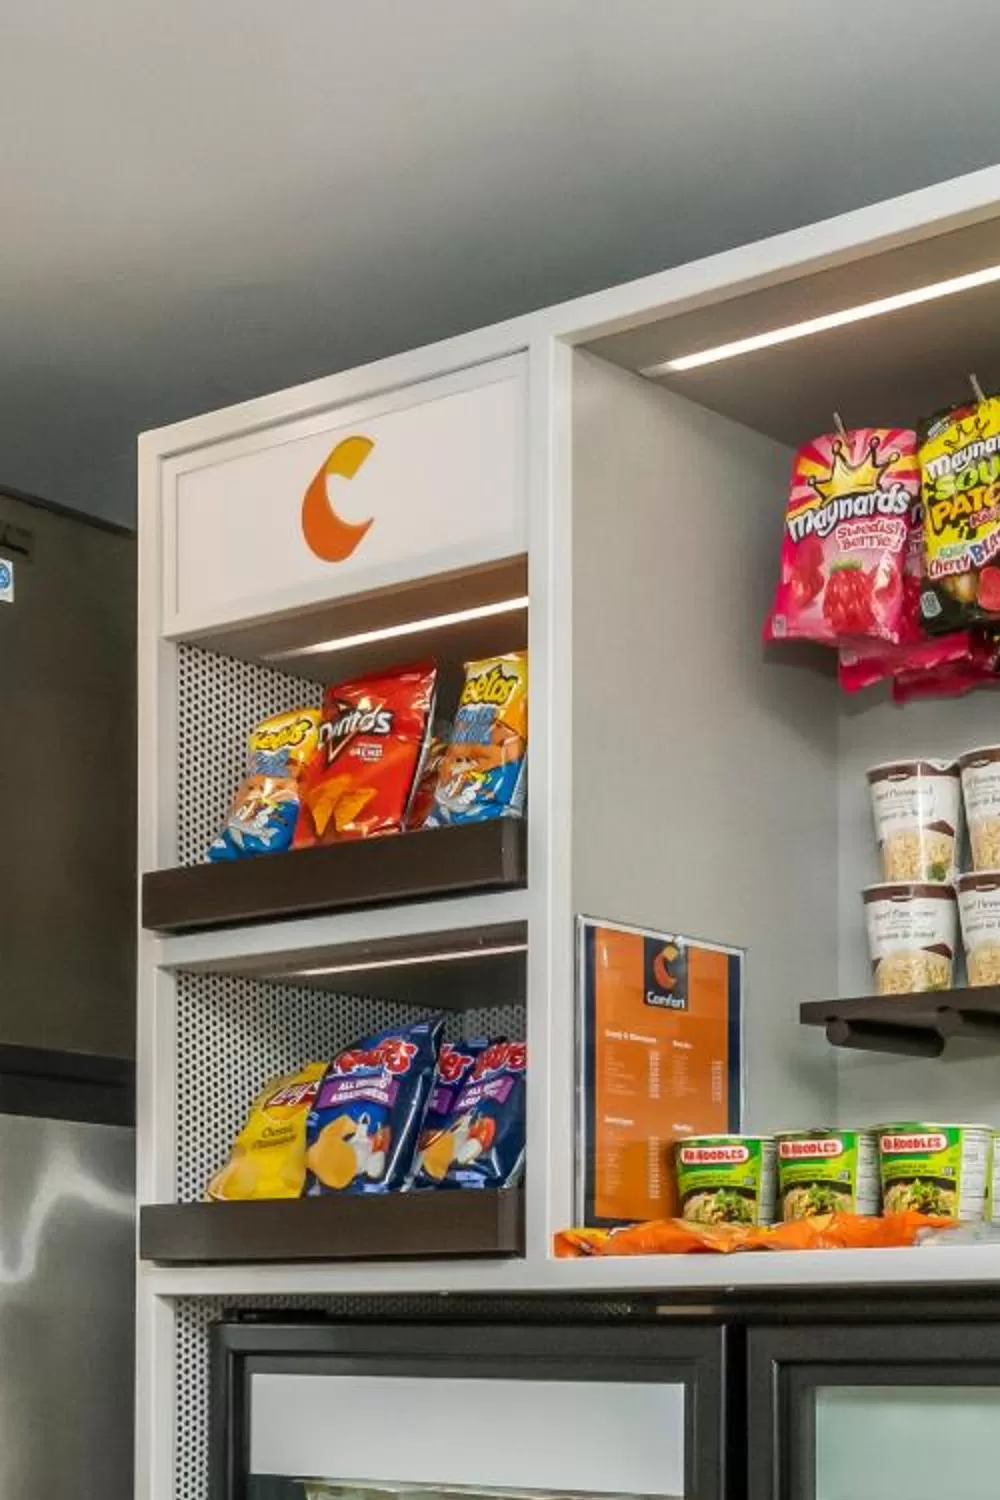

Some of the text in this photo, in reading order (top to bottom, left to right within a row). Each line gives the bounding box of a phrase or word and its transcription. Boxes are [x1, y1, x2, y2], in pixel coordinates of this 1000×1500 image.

[791, 1142, 837, 1154] NOODLES
[894, 1136, 942, 1149] NOODLES
[696, 1147, 745, 1161] NOODLES
